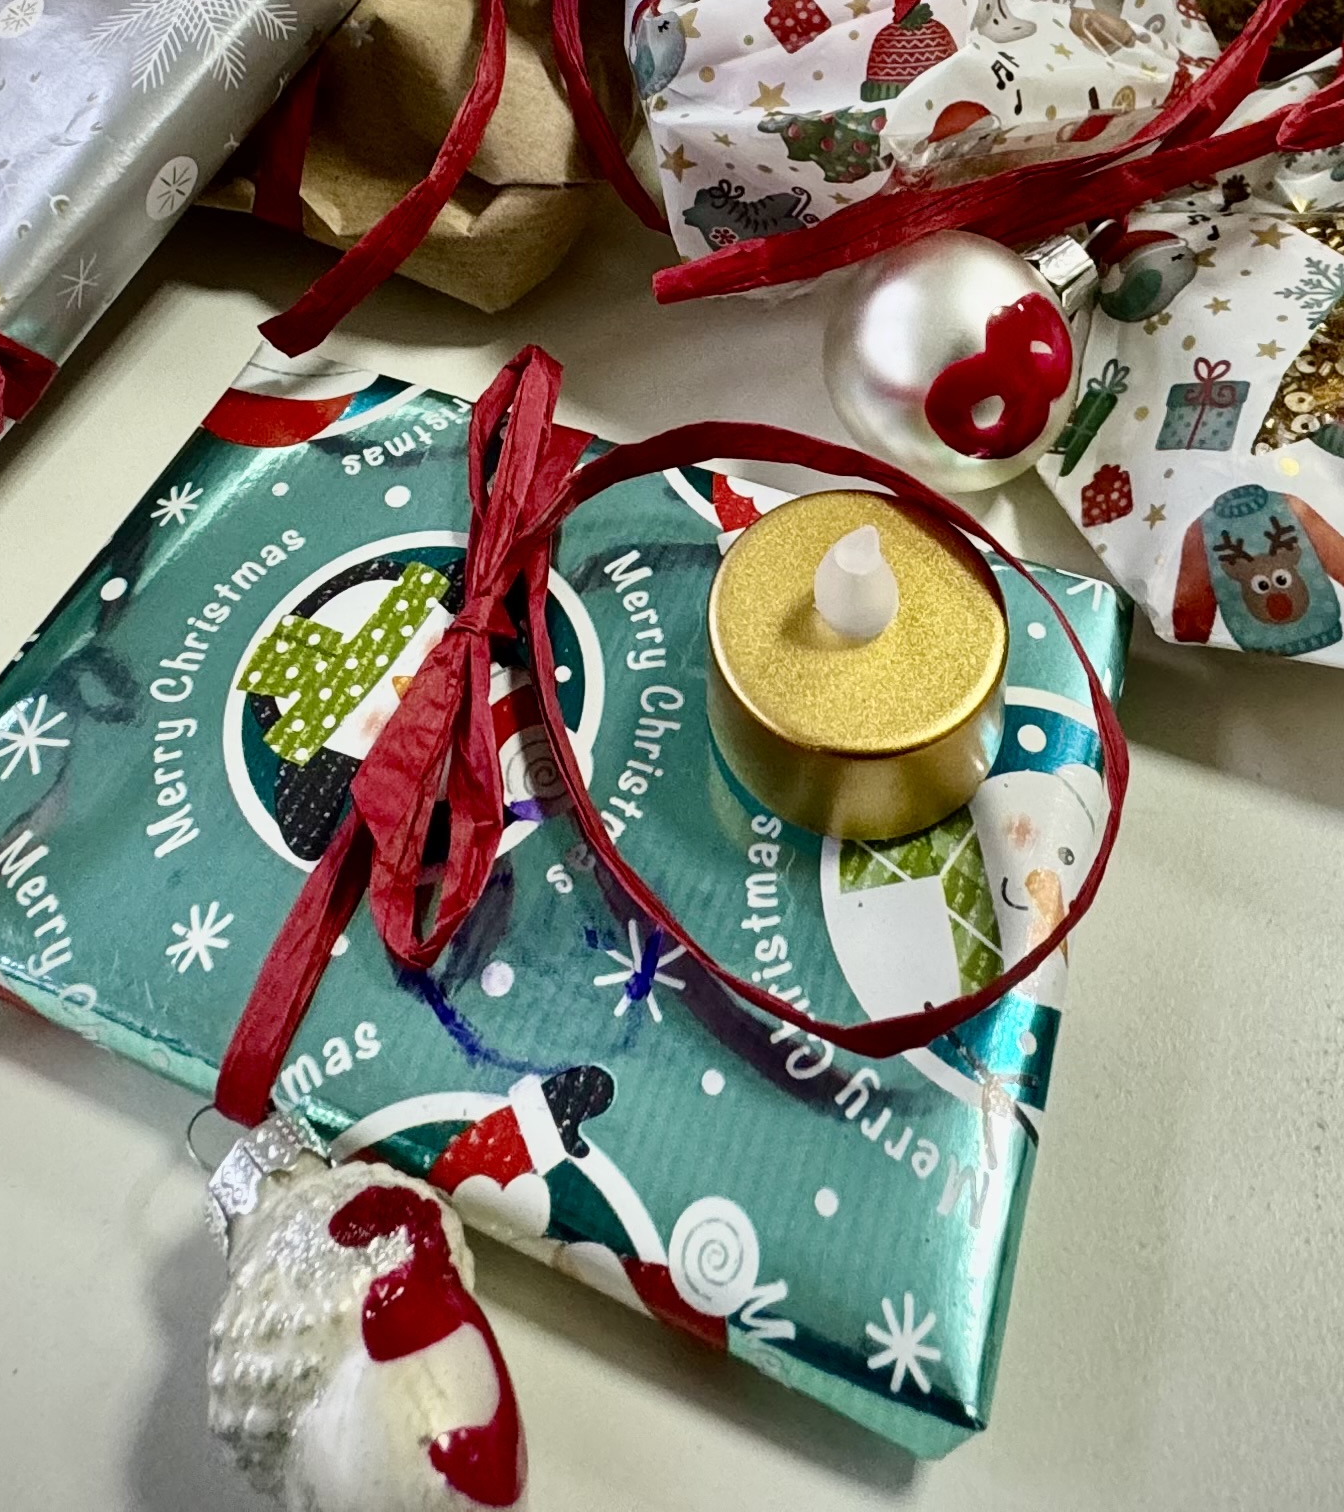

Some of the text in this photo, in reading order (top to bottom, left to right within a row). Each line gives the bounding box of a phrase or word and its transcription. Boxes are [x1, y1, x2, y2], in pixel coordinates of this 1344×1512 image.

[341, 396, 473, 476] ristmas
[603, 549, 667, 671] Merry
[146, 528, 307, 859] Merry Christmas
[833, 1066, 990, 1230] Merry
